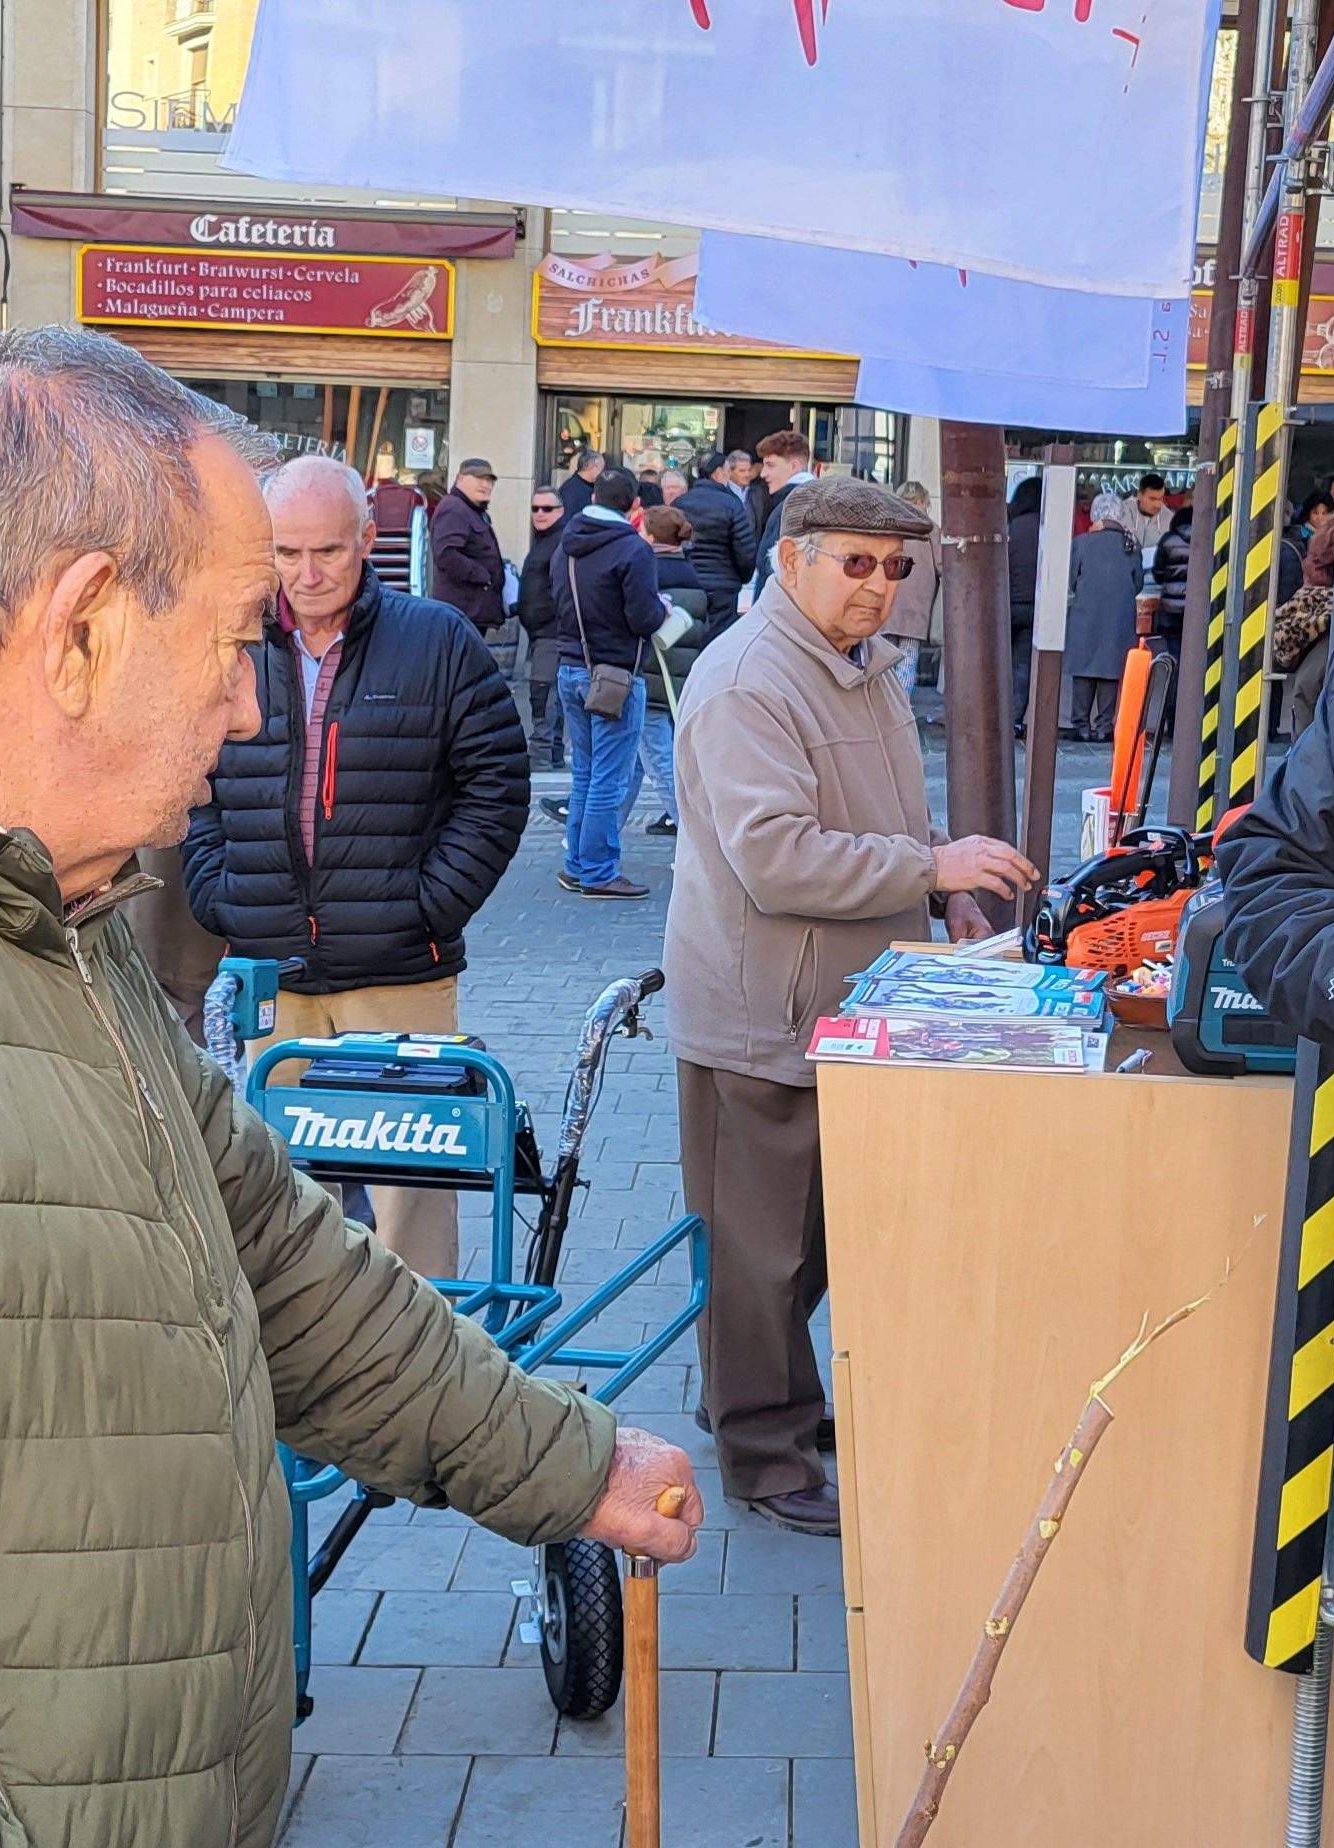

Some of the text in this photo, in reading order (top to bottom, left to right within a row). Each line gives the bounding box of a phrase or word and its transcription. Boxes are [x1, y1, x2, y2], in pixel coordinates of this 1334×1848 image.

[1275, 215, 1290, 278] ALTRAD
[105, 257, 361, 285] Frankfurt Bratwurst Cervela
[548, 262, 651, 289] SALCHICHAS
[105, 278, 195, 298] Bocadillos
[198, 285, 237, 303] para
[105, 299, 285, 323] Malagueña Campera
[564, 298, 734, 338] Frankfu
